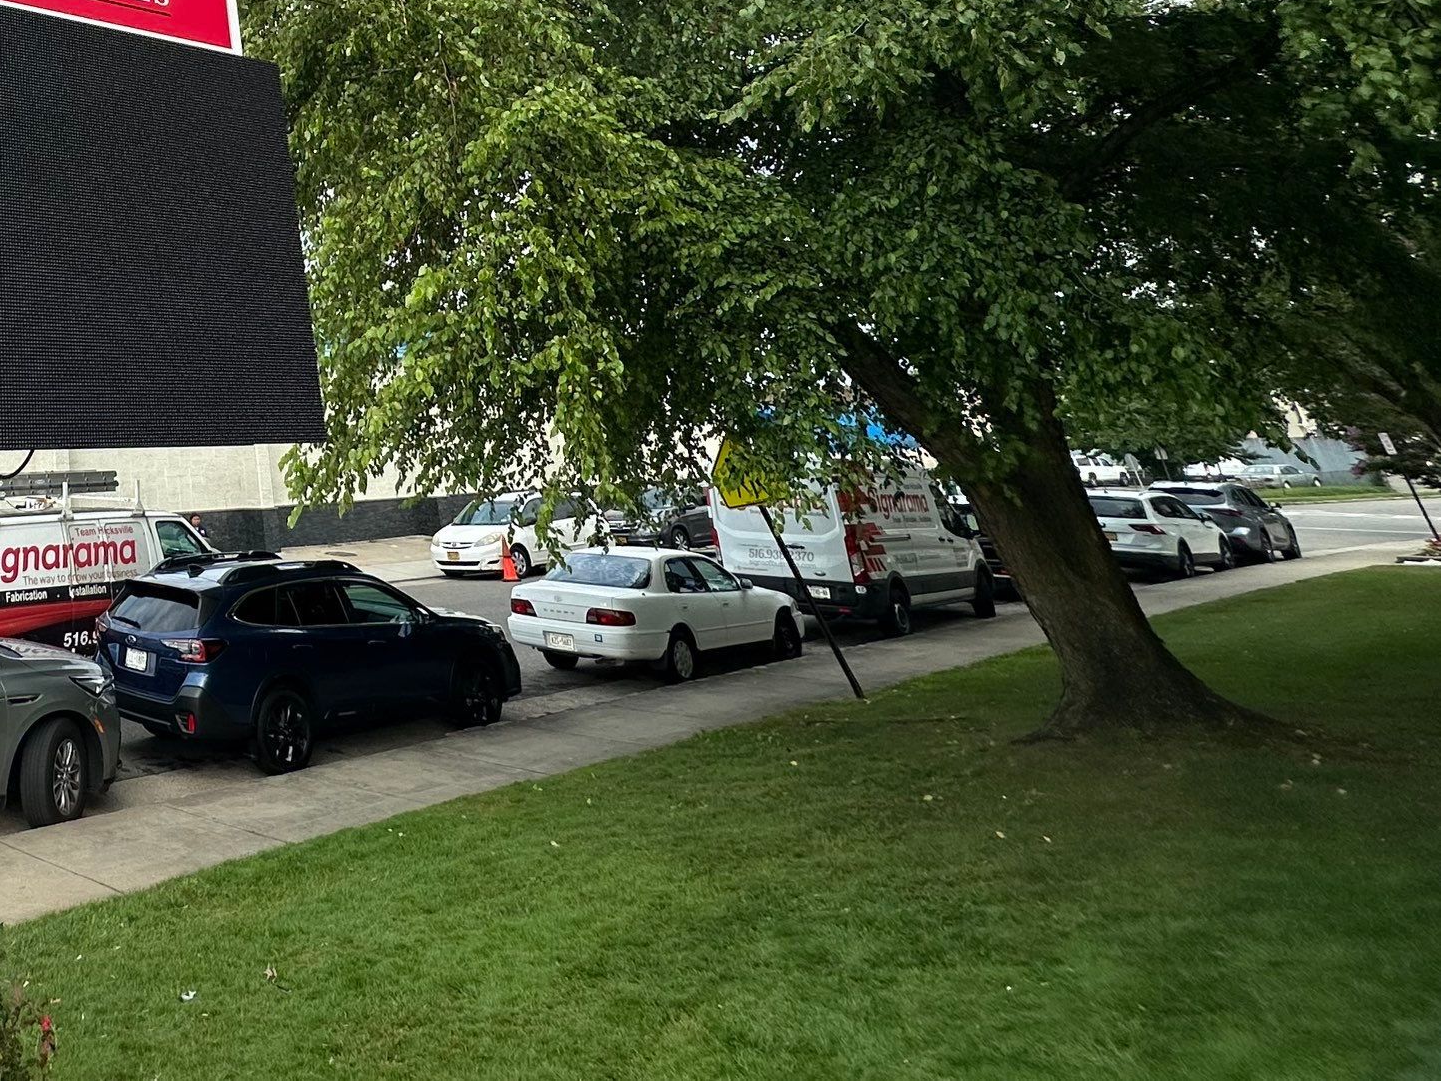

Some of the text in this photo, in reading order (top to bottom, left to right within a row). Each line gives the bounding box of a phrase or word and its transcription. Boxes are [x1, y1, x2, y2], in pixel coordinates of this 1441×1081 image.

[75, 527, 97, 537] Team
[23, 575, 38, 586] The
[39, 575, 56, 585] way
[56, 574, 67, 584] to
[5, 584, 107, 603] Fabrication Installation
